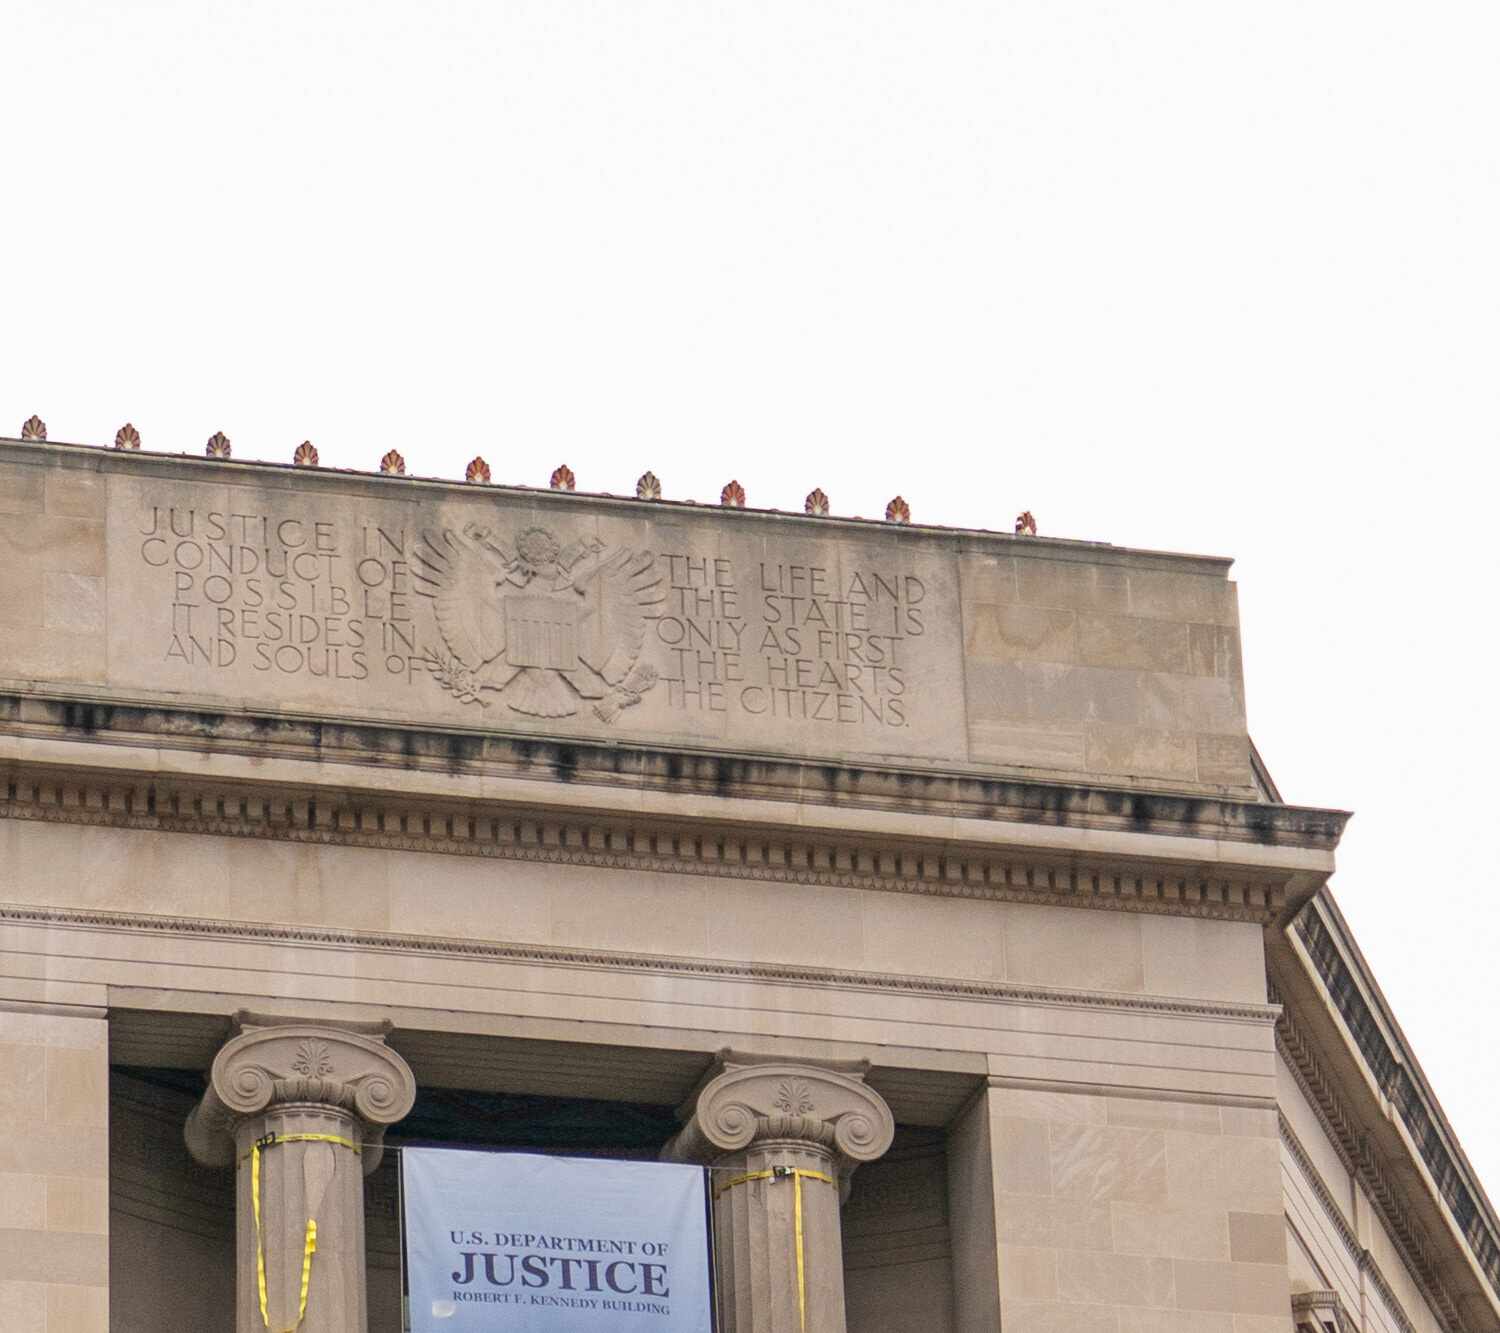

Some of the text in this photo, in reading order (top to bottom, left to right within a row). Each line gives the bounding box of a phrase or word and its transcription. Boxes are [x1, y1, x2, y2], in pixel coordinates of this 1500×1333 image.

[140, 507, 926, 604] JUSTICE IN THE LIFE AND
[141, 538, 925, 636] CONDUCT OF THE STATE IS
[172, 603, 905, 696] IT RESIDES IN THE HEARTS
[175, 571, 904, 664] POSSIBLE ONLY AS FIRST
[164, 634, 910, 728] AND SOULS OF THE CITIZENS.
[450, 1230, 669, 1257] U.S. DEPARTMENT OF
[451, 1252, 670, 1298] JUSTICE
[452, 1291, 671, 1316] ROBERT F. KENNEDY BUILDING
